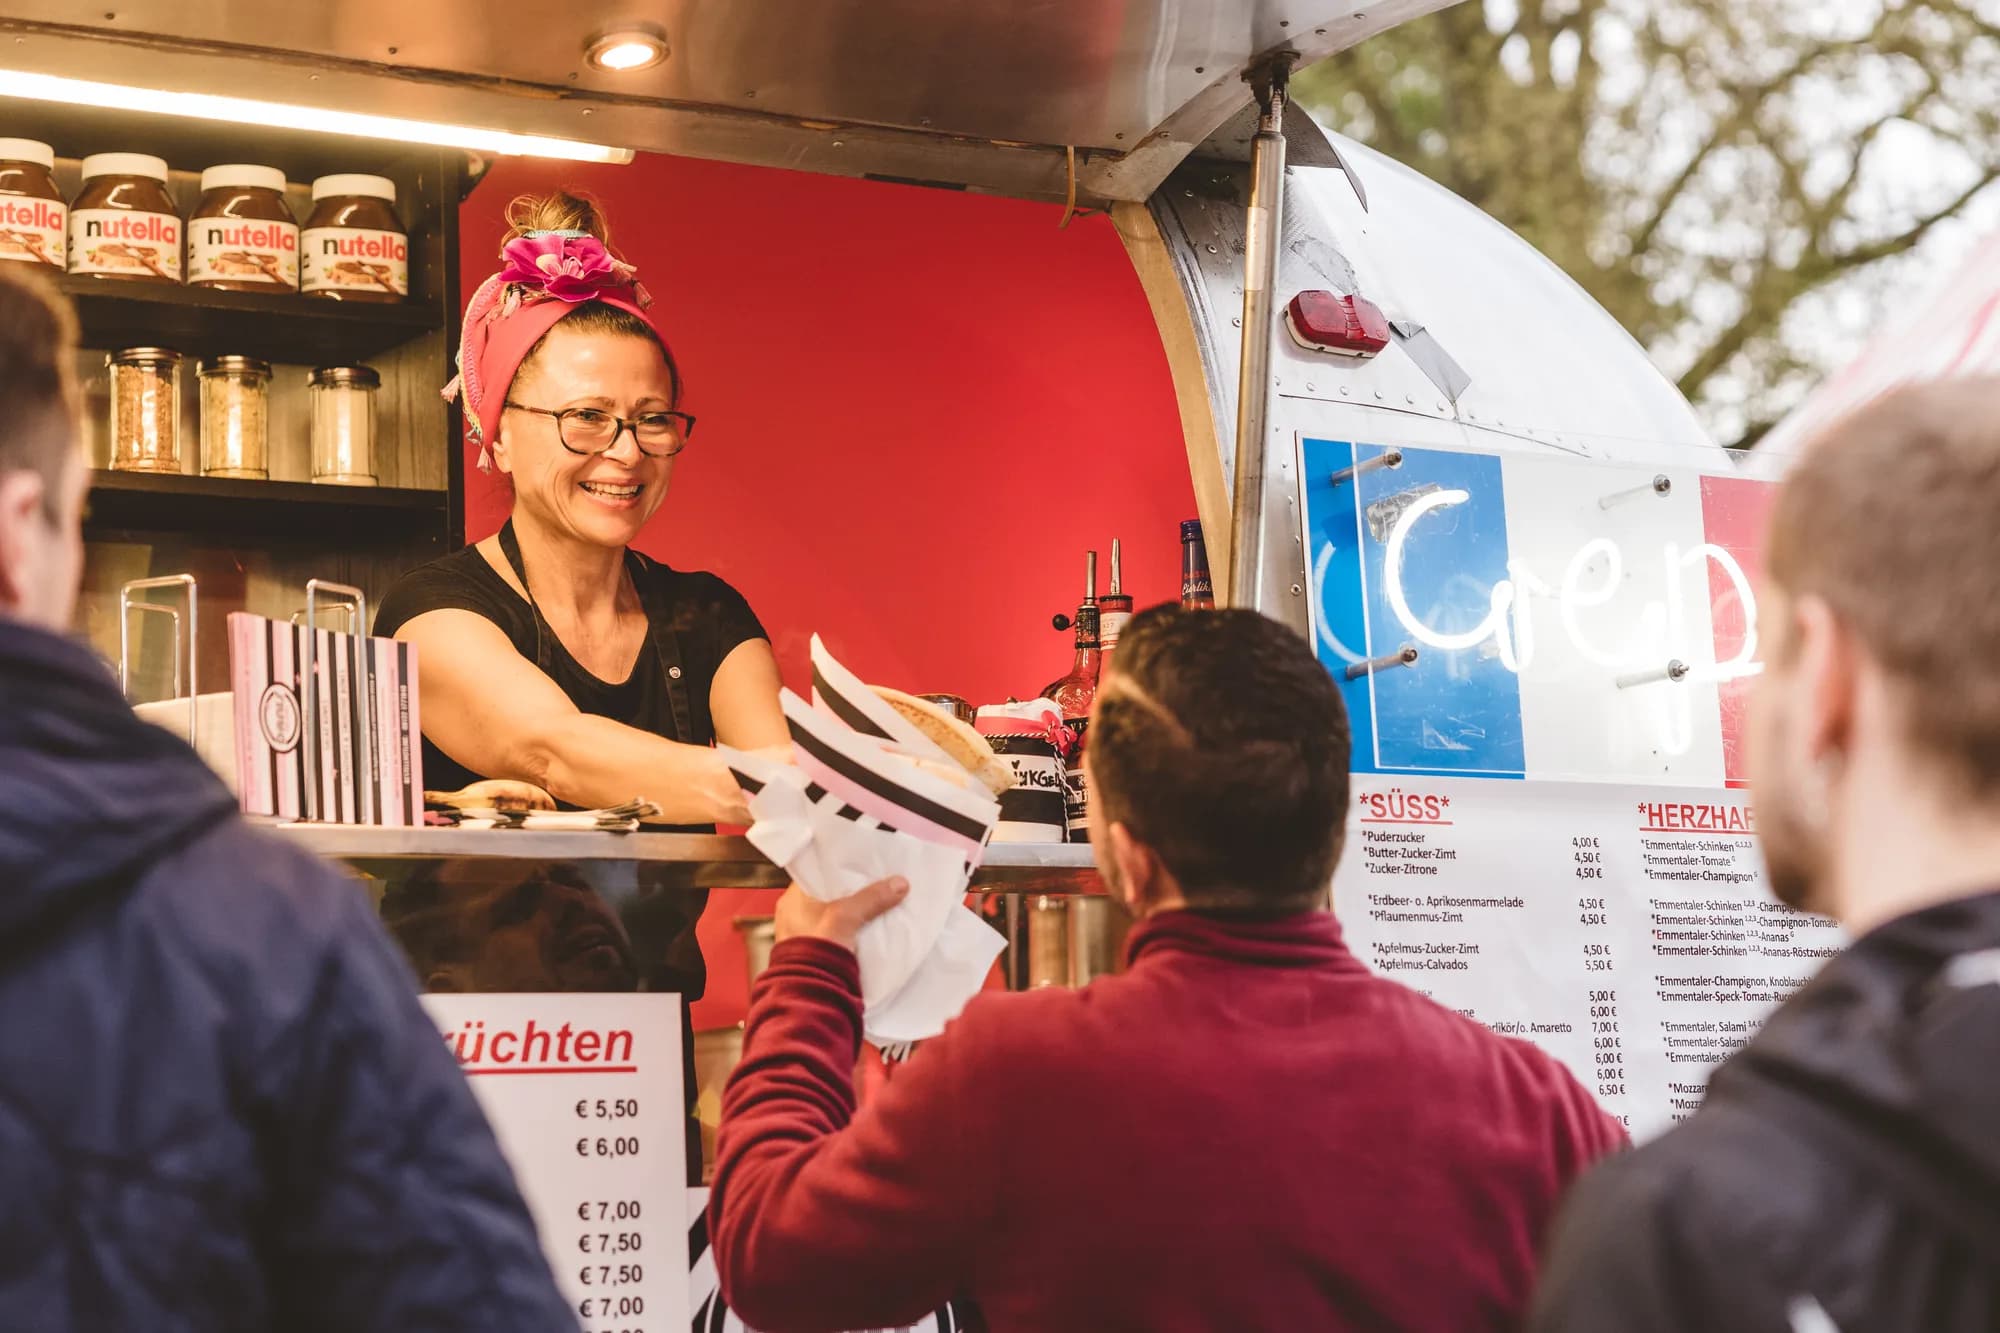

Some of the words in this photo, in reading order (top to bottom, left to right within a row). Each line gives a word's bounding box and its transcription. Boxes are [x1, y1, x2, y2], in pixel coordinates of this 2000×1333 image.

[0, 202, 62, 231] tella
[86, 215, 177, 244] nutella
[207, 223, 295, 251] nutella
[322, 234, 406, 262] nutella
[1572, 837, 1592, 848] 4,00
[1593, 837, 1600, 848] €
[1574, 852, 1594, 864] 4,50
[1595, 852, 1601, 863] €
[1576, 867, 1595, 880] 4,50
[1596, 867, 1602, 879] €
[1415, 898, 1424, 906] o.
[1426, 896, 1524, 909] Aprikosenmarmelade
[1579, 898, 1598, 910] 4,50
[1599, 898, 1605, 909] €
[1580, 914, 1600, 926] 4,50
[1600, 914, 1607, 925] €
[1583, 945, 1603, 957] 4,50
[1604, 945, 1611, 955] €
[1585, 960, 1605, 972] 5,50
[1606, 960, 1613, 971] €
[1589, 991, 1608, 1003] 5,00
[1610, 991, 1616, 1002] €
[1590, 1006, 1609, 1018] 6,00
[1611, 1006, 1617, 1017] €
[1530, 1022, 1572, 1033] Amaretto
[1591, 1022, 1612, 1034] 7,00
[1613, 1022, 1619, 1033] €
[1719, 1021, 1747, 1032] Salami
[1594, 1037, 1613, 1049] 6,00
[1615, 1037, 1621, 1048] €
[1595, 1053, 1614, 1065] 6,00
[1616, 1053, 1623, 1064] €
[1597, 1069, 1616, 1081] 6,00
[1618, 1069, 1624, 1080] €
[1599, 1084, 1618, 1096] 6,50
[1619, 1084, 1626, 1095] €
[1668, 1083, 1707, 1094] Mozzar
[576, 1099, 588, 1118] €
[595, 1099, 638, 1120] 5,50
[576, 1137, 589, 1156] €
[596, 1137, 639, 1158] 6,00
[578, 1202, 590, 1220] €
[597, 1201, 641, 1222] 7,00
[579, 1234, 591, 1252] €
[598, 1233, 642, 1254] 7,50
[580, 1266, 592, 1285] €
[599, 1265, 643, 1287] 7,50
[579, 1298, 593, 1318] €
[600, 1296, 643, 1319] 7,00
